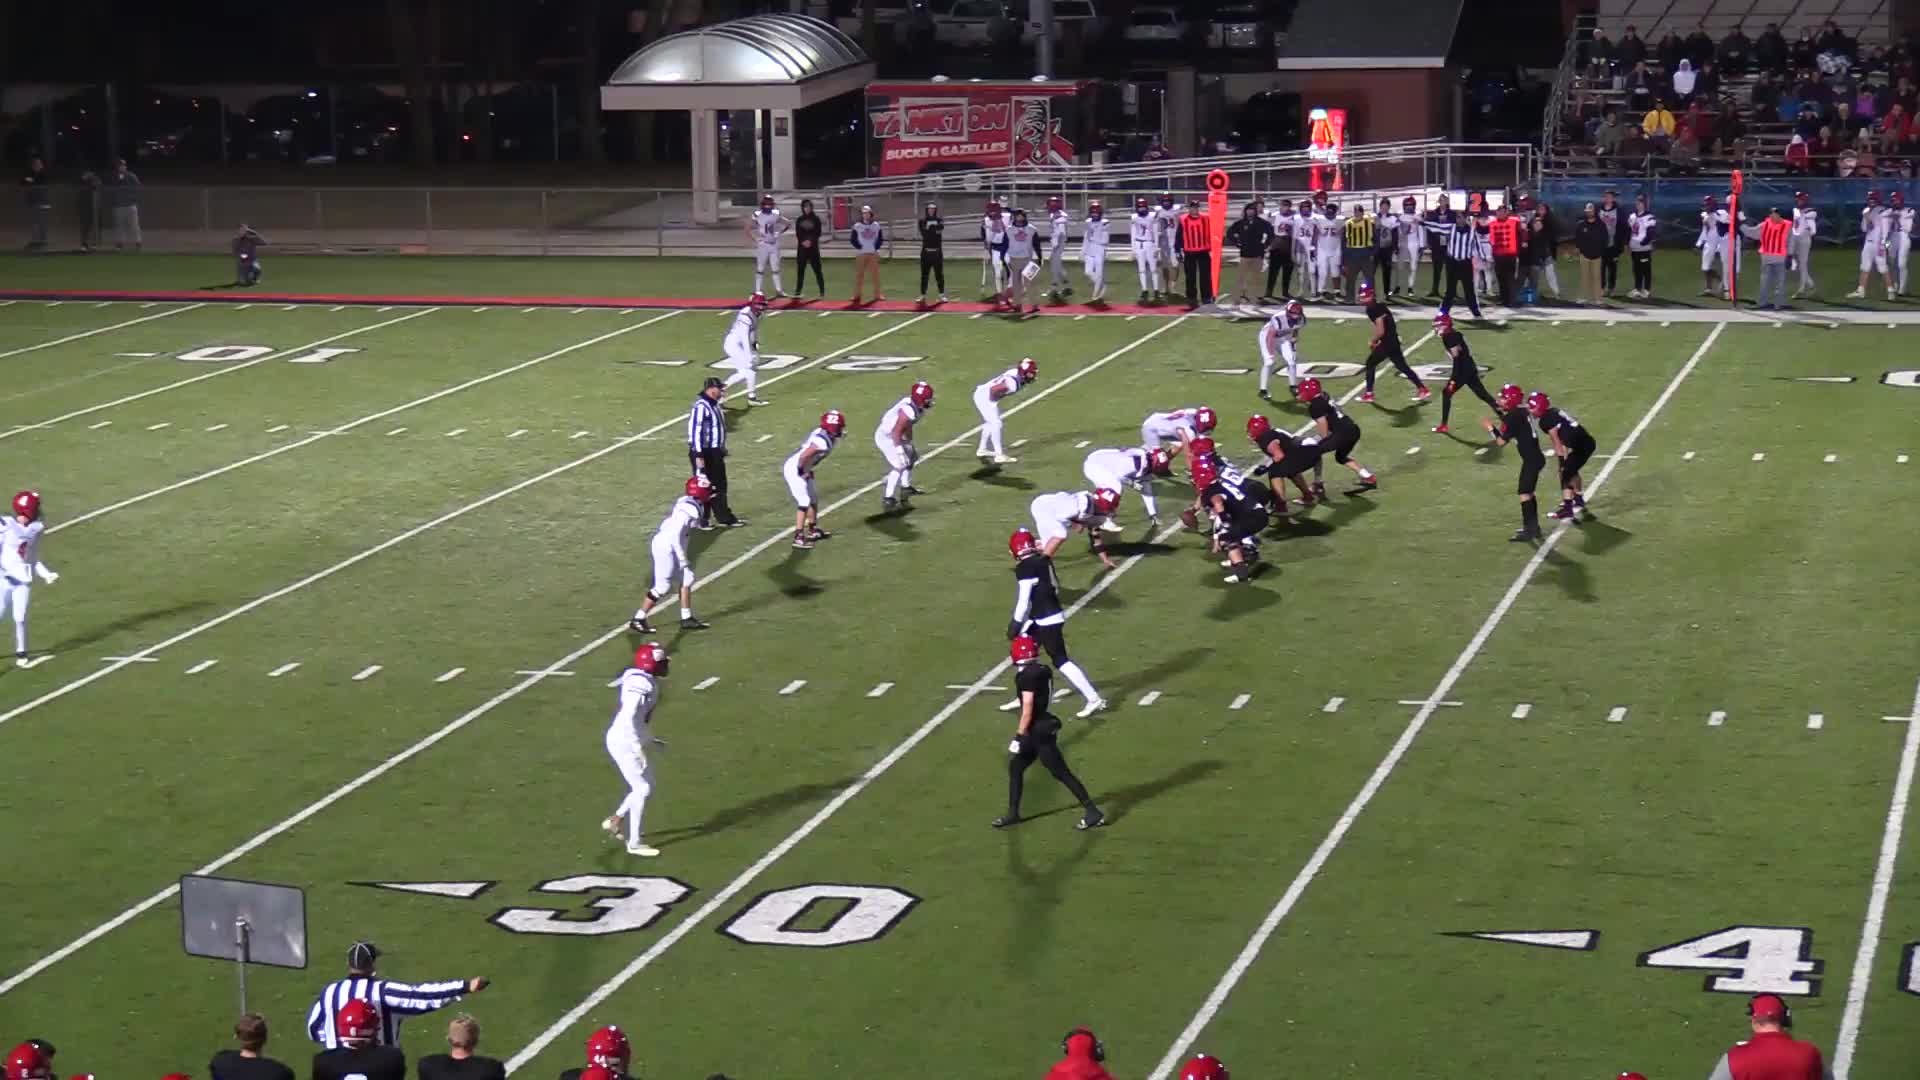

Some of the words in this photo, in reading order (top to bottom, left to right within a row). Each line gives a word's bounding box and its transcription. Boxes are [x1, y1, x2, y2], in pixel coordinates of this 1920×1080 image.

[869, 102, 1010, 140] YANKTON
[886, 147, 930, 160] BUCKS
[940, 141, 1008, 157] GAZELLES
[1470, 193, 1481, 212] 2
